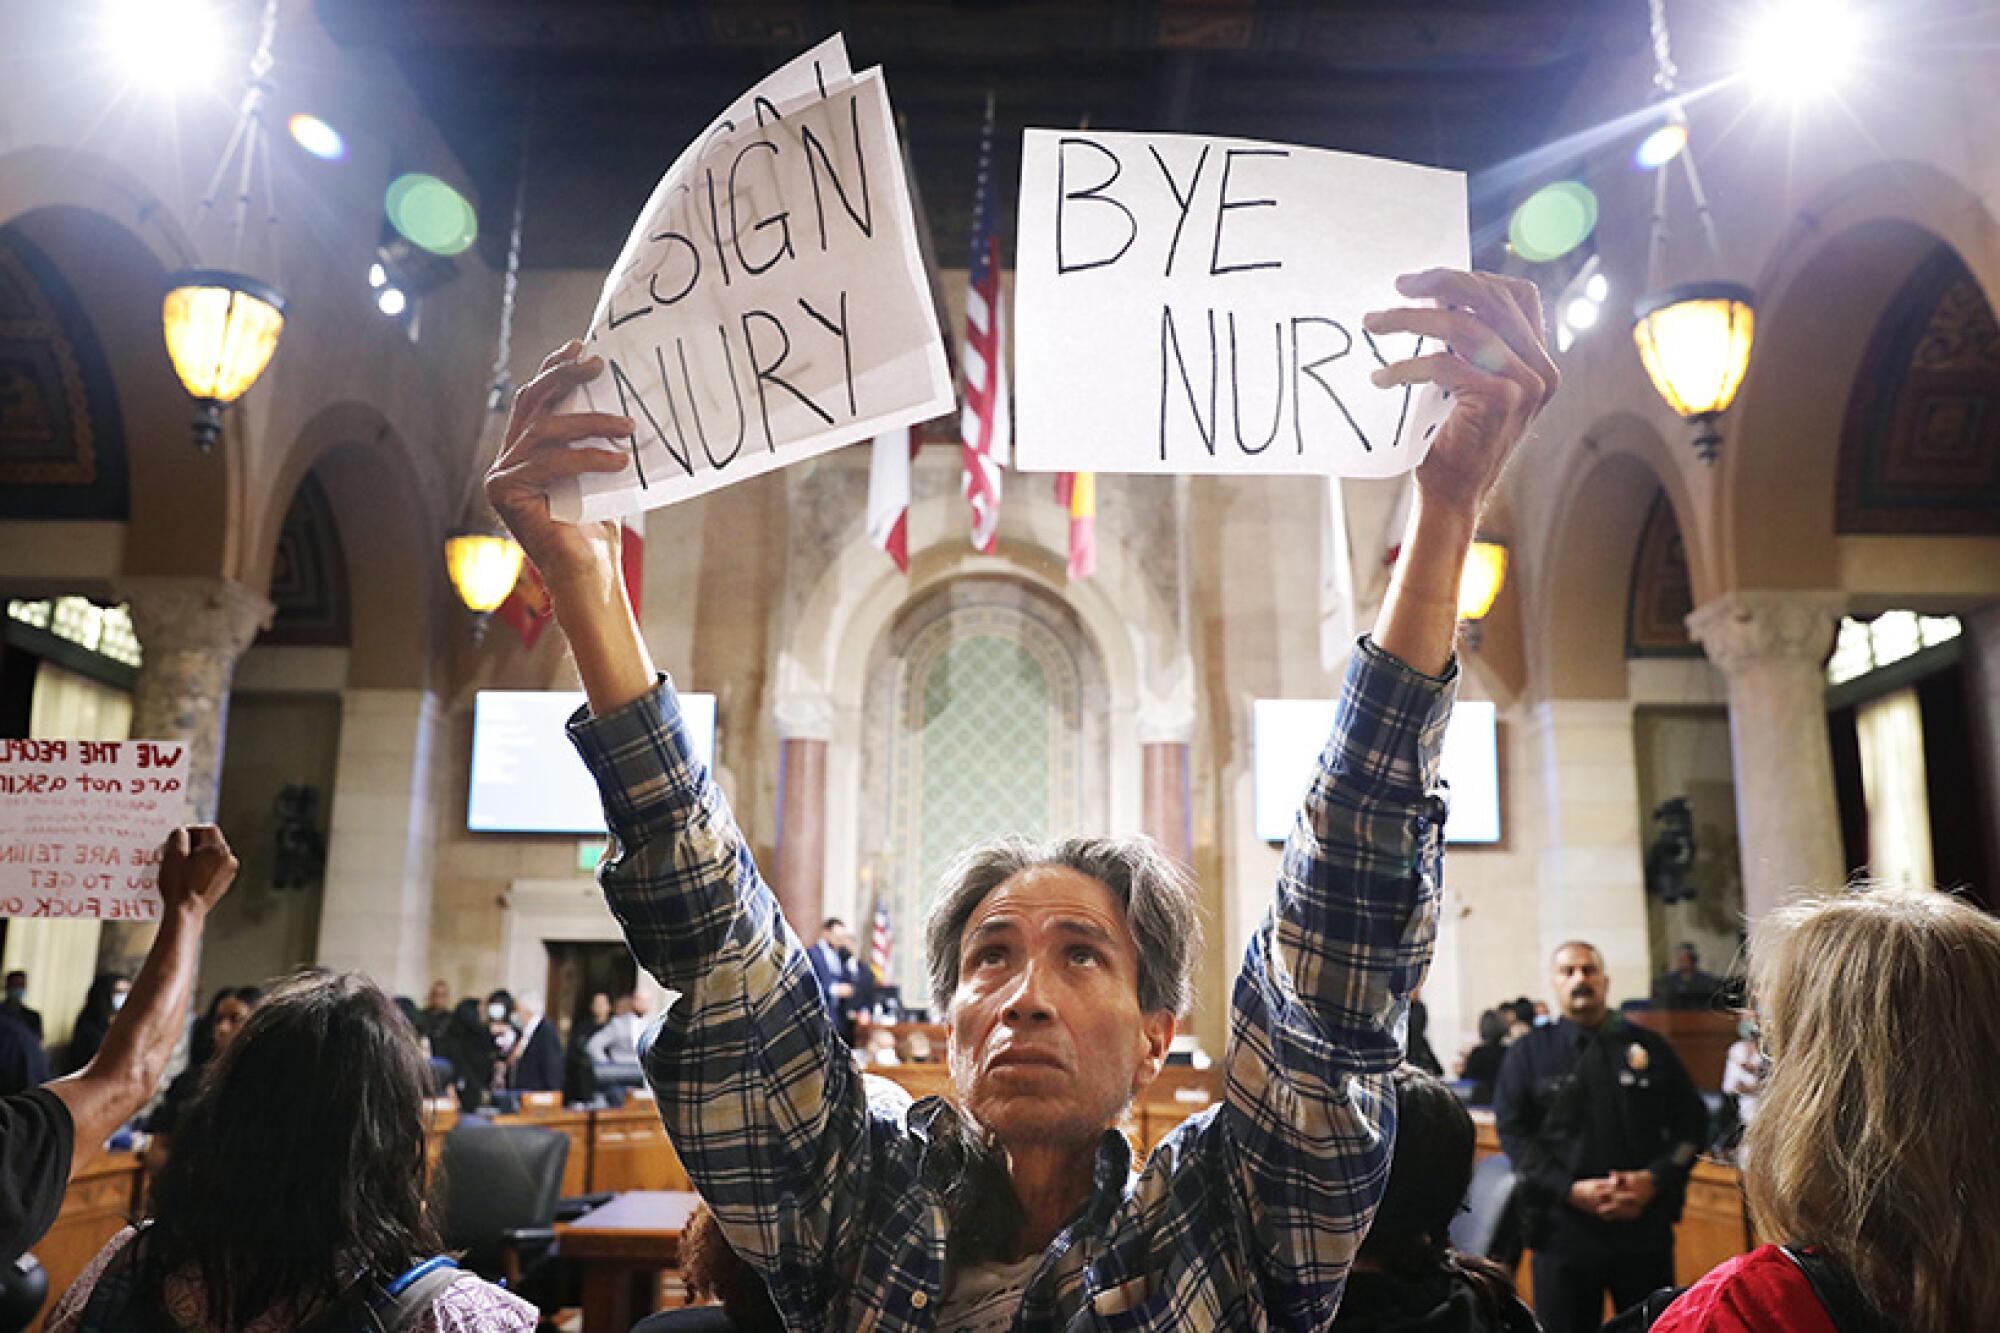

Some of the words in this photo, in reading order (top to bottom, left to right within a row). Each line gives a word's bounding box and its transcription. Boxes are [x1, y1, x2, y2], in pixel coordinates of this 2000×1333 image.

[592, 95, 871, 338] SIGN
[1056, 138, 1289, 276] BYE
[609, 290, 856, 489] NURY
